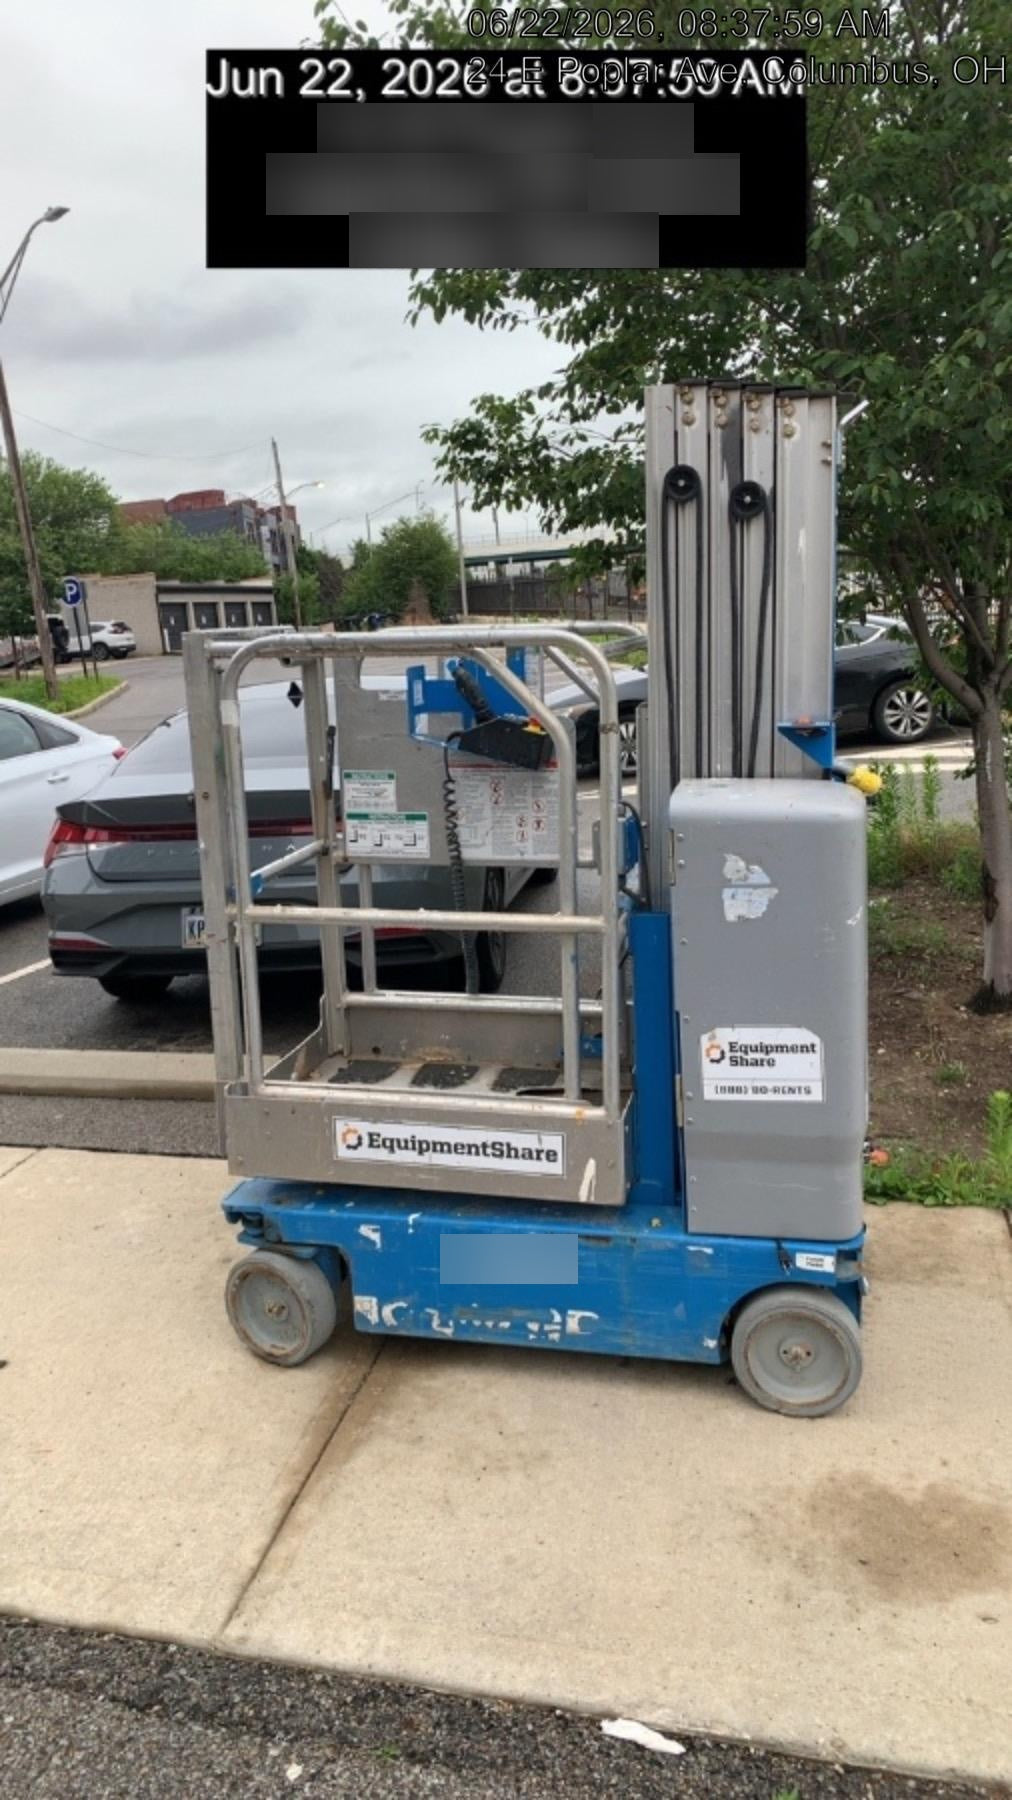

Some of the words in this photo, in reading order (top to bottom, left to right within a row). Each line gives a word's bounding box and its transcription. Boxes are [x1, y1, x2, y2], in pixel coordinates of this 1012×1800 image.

[65, 583, 77, 602] P
[728, 1041, 816, 1056] Equipment
[729, 1055, 776, 1068] Share
[367, 1131, 559, 1163] EquipmentShare
